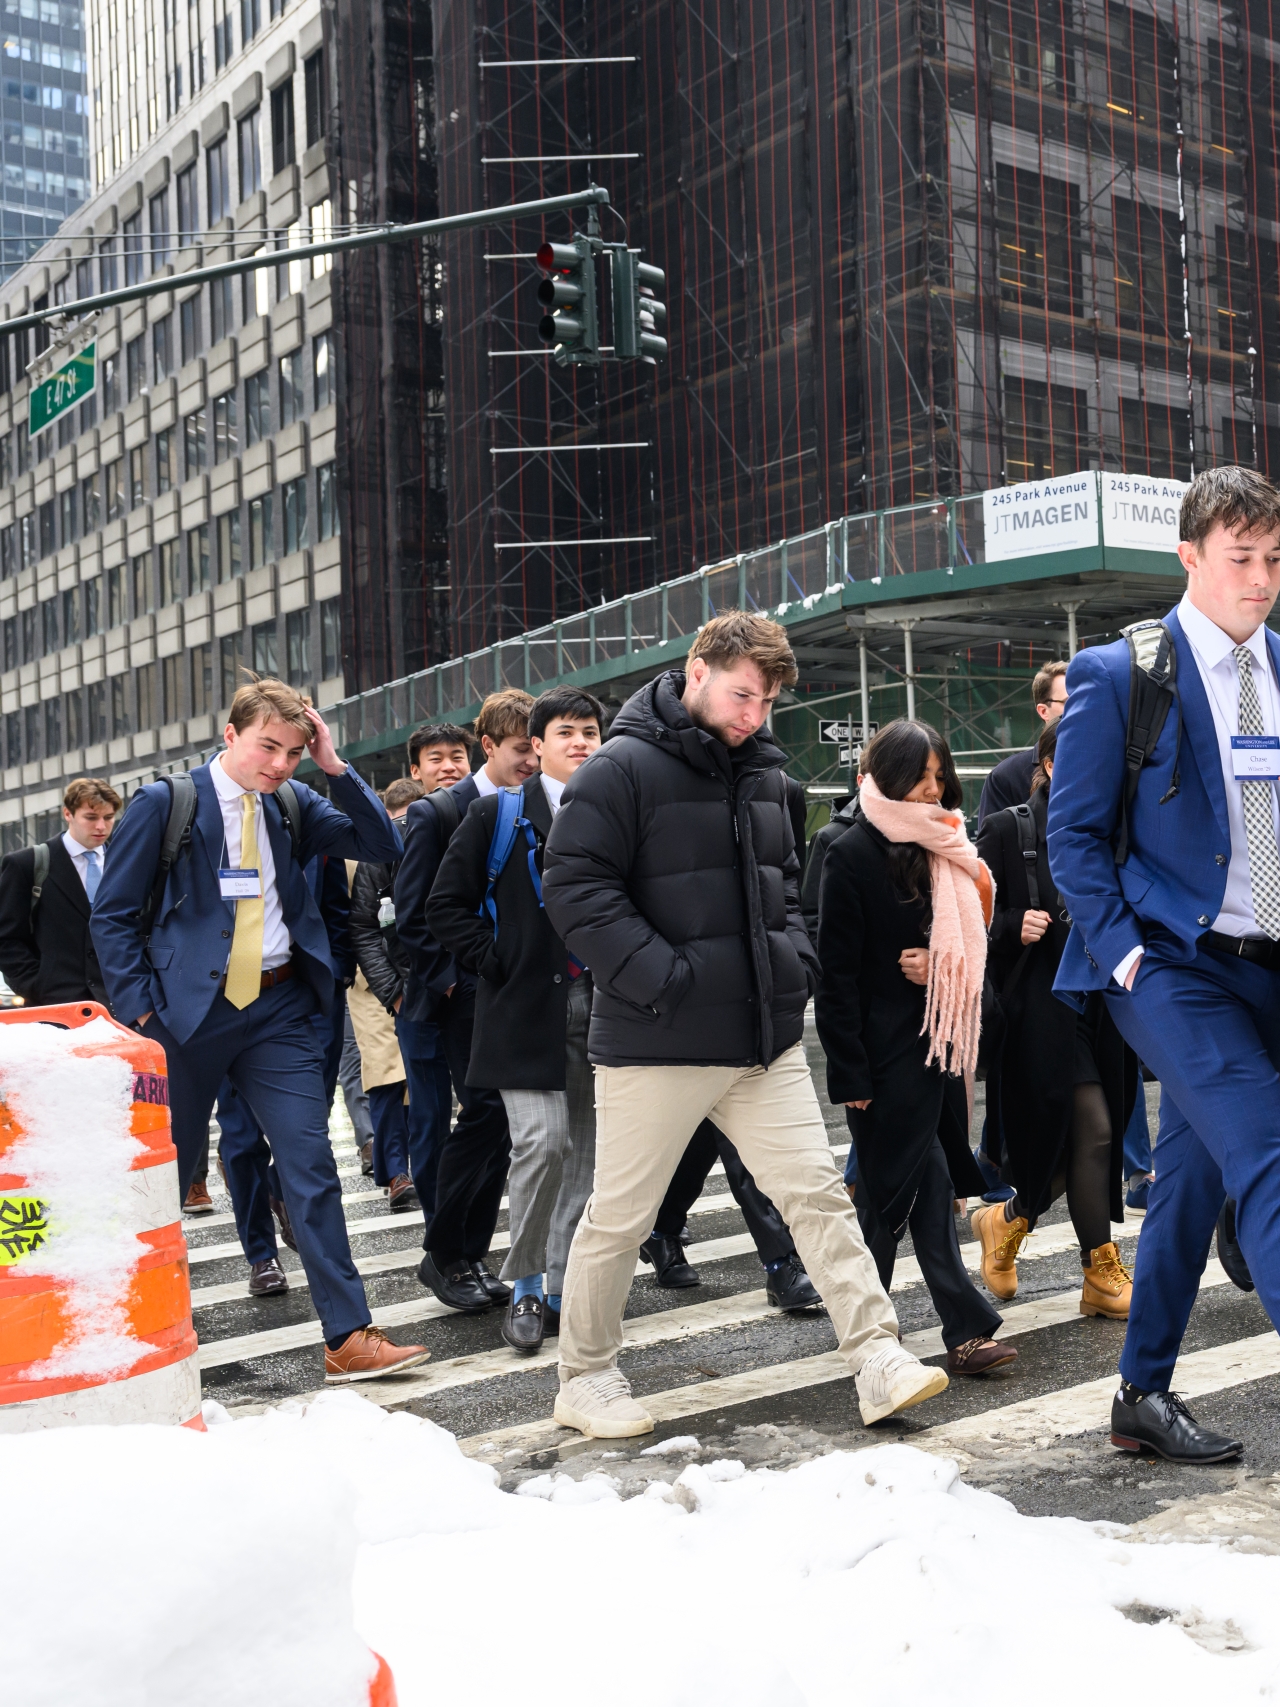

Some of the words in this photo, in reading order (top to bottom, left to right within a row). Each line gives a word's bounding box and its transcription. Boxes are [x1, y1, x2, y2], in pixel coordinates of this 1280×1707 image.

[47, 385, 52, 414] E
[54, 374, 64, 407] 47
[992, 494, 1011, 506] 245
[1015, 487, 1041, 502] Park
[1044, 482, 1087, 496] Avenue
[1111, 480, 1130, 493] 245
[1134, 483, 1158, 496] Park
[994, 501, 1088, 534] JTMAGEN
[1112, 501, 1181, 526] JTMAG
[832, 728, 848, 736] ONE
